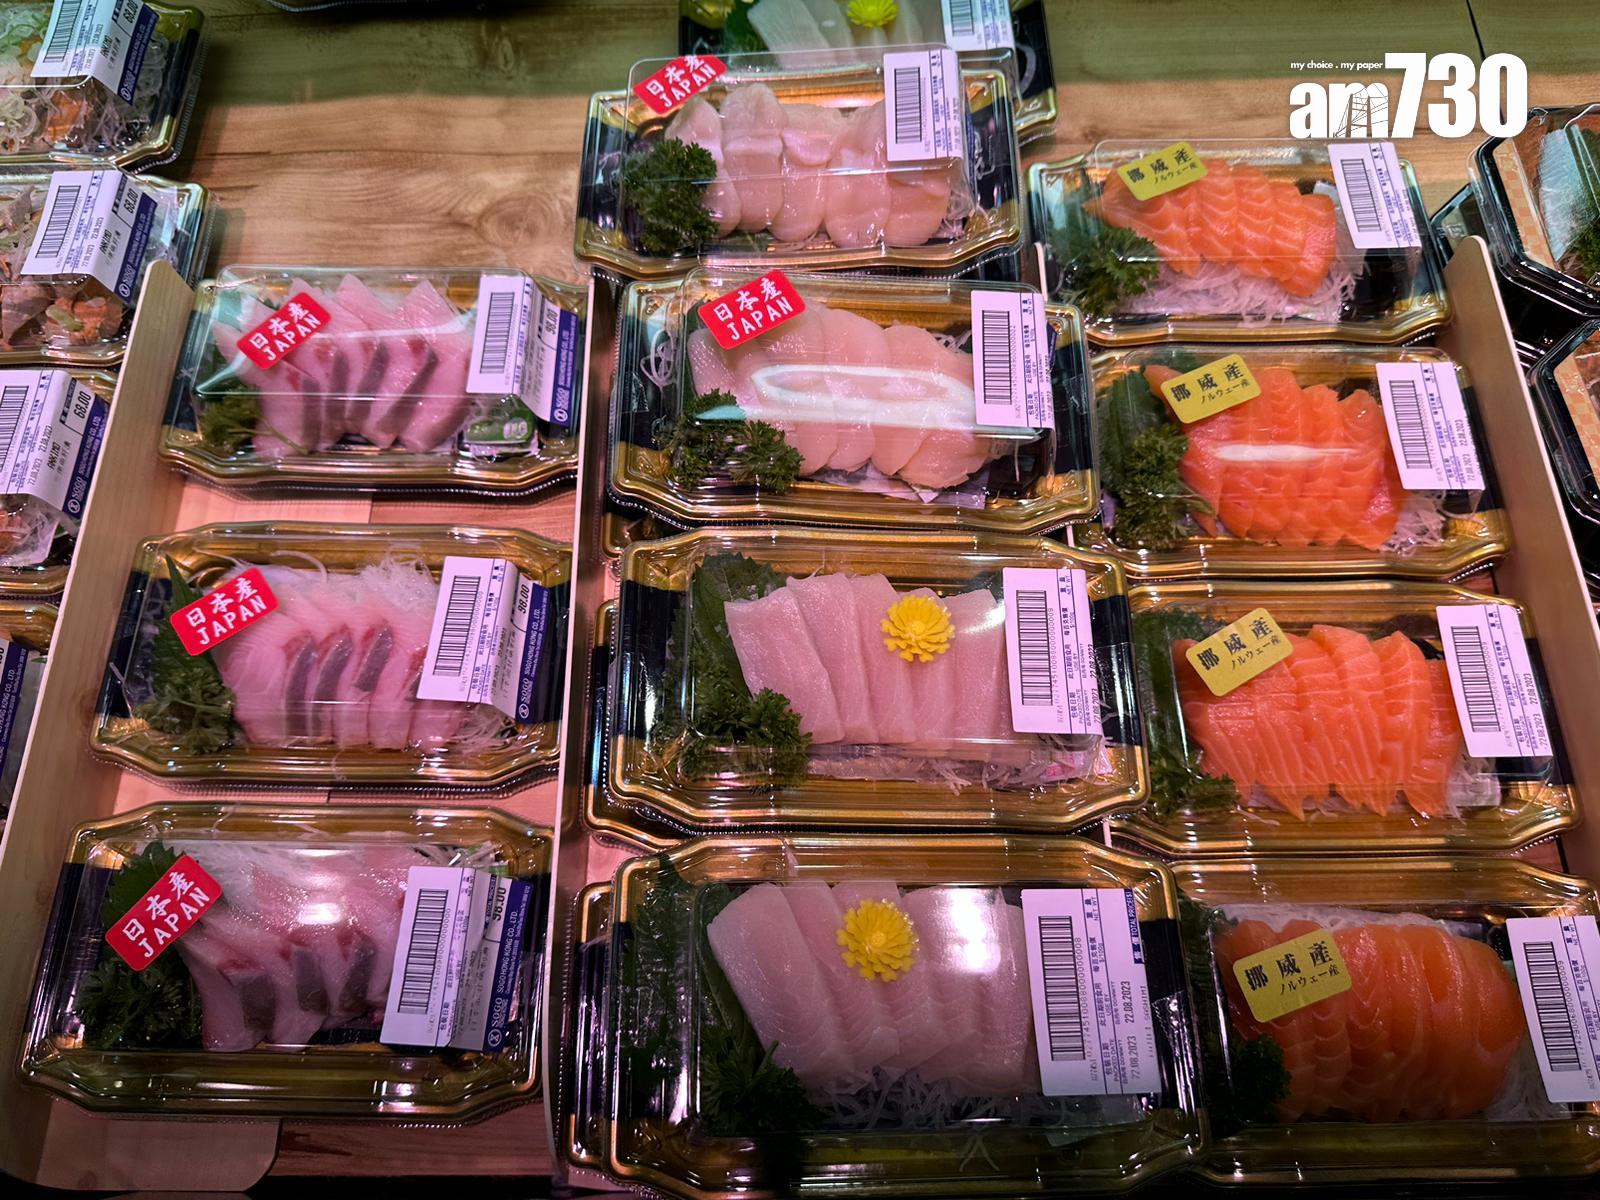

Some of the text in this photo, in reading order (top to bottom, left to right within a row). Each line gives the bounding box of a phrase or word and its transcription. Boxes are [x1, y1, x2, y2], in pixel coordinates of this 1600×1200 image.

[659, 64, 717, 107] JAPAN
[123, 188, 139, 214] 68.00
[726, 296, 794, 341] JAPAN
[263, 313, 322, 361] JAPAN
[73, 390, 92, 419] 68.00
[1455, 419, 1468, 447] 22.08.2023
[48, 441, 62, 470] ANKIMO
[1462, 453, 1475, 481] 22.08.2023
[518, 583, 530, 614] 98.00
[196, 595, 267, 645] JAPAN
[1062, 607, 1070, 636] 每百克售價
[526, 645, 535, 661] HONG
[529, 630, 538, 646] KONG
[1065, 643, 1074, 679] 此日期前食用
[520, 677, 529, 703] SOGO
[1524, 673, 1538, 705] 22.08.2023
[1069, 692, 1079, 719] 包裝日期
[1533, 713, 1547, 746] 22.08.2023
[493, 886, 506, 921] 98.00
[1084, 898, 1093, 918] 重量
[1091, 895, 1098, 907] WT
[138, 887, 210, 958] JAPAN
[509, 910, 519, 924] LTD.
[1128, 918, 1138, 937] TOTAL
[503, 938, 514, 956] KONG
[1089, 936, 1100, 972] 每百克售價
[1571, 934, 1579, 946] NET
[500, 956, 510, 976] HONG
[497, 976, 507, 994] SOGO
[491, 997, 503, 1028] SOGO
[1095, 981, 1107, 1027] 此日期前食用
[1121, 980, 1135, 1024] 22.08.2023
[1582, 1001, 1597, 1040] 此日期前食用
[1102, 1042, 1113, 1076] 包裝日期
[1109, 1038, 1119, 1082] PACKED DATE
[1127, 1035, 1141, 1080] 22.08.2023
